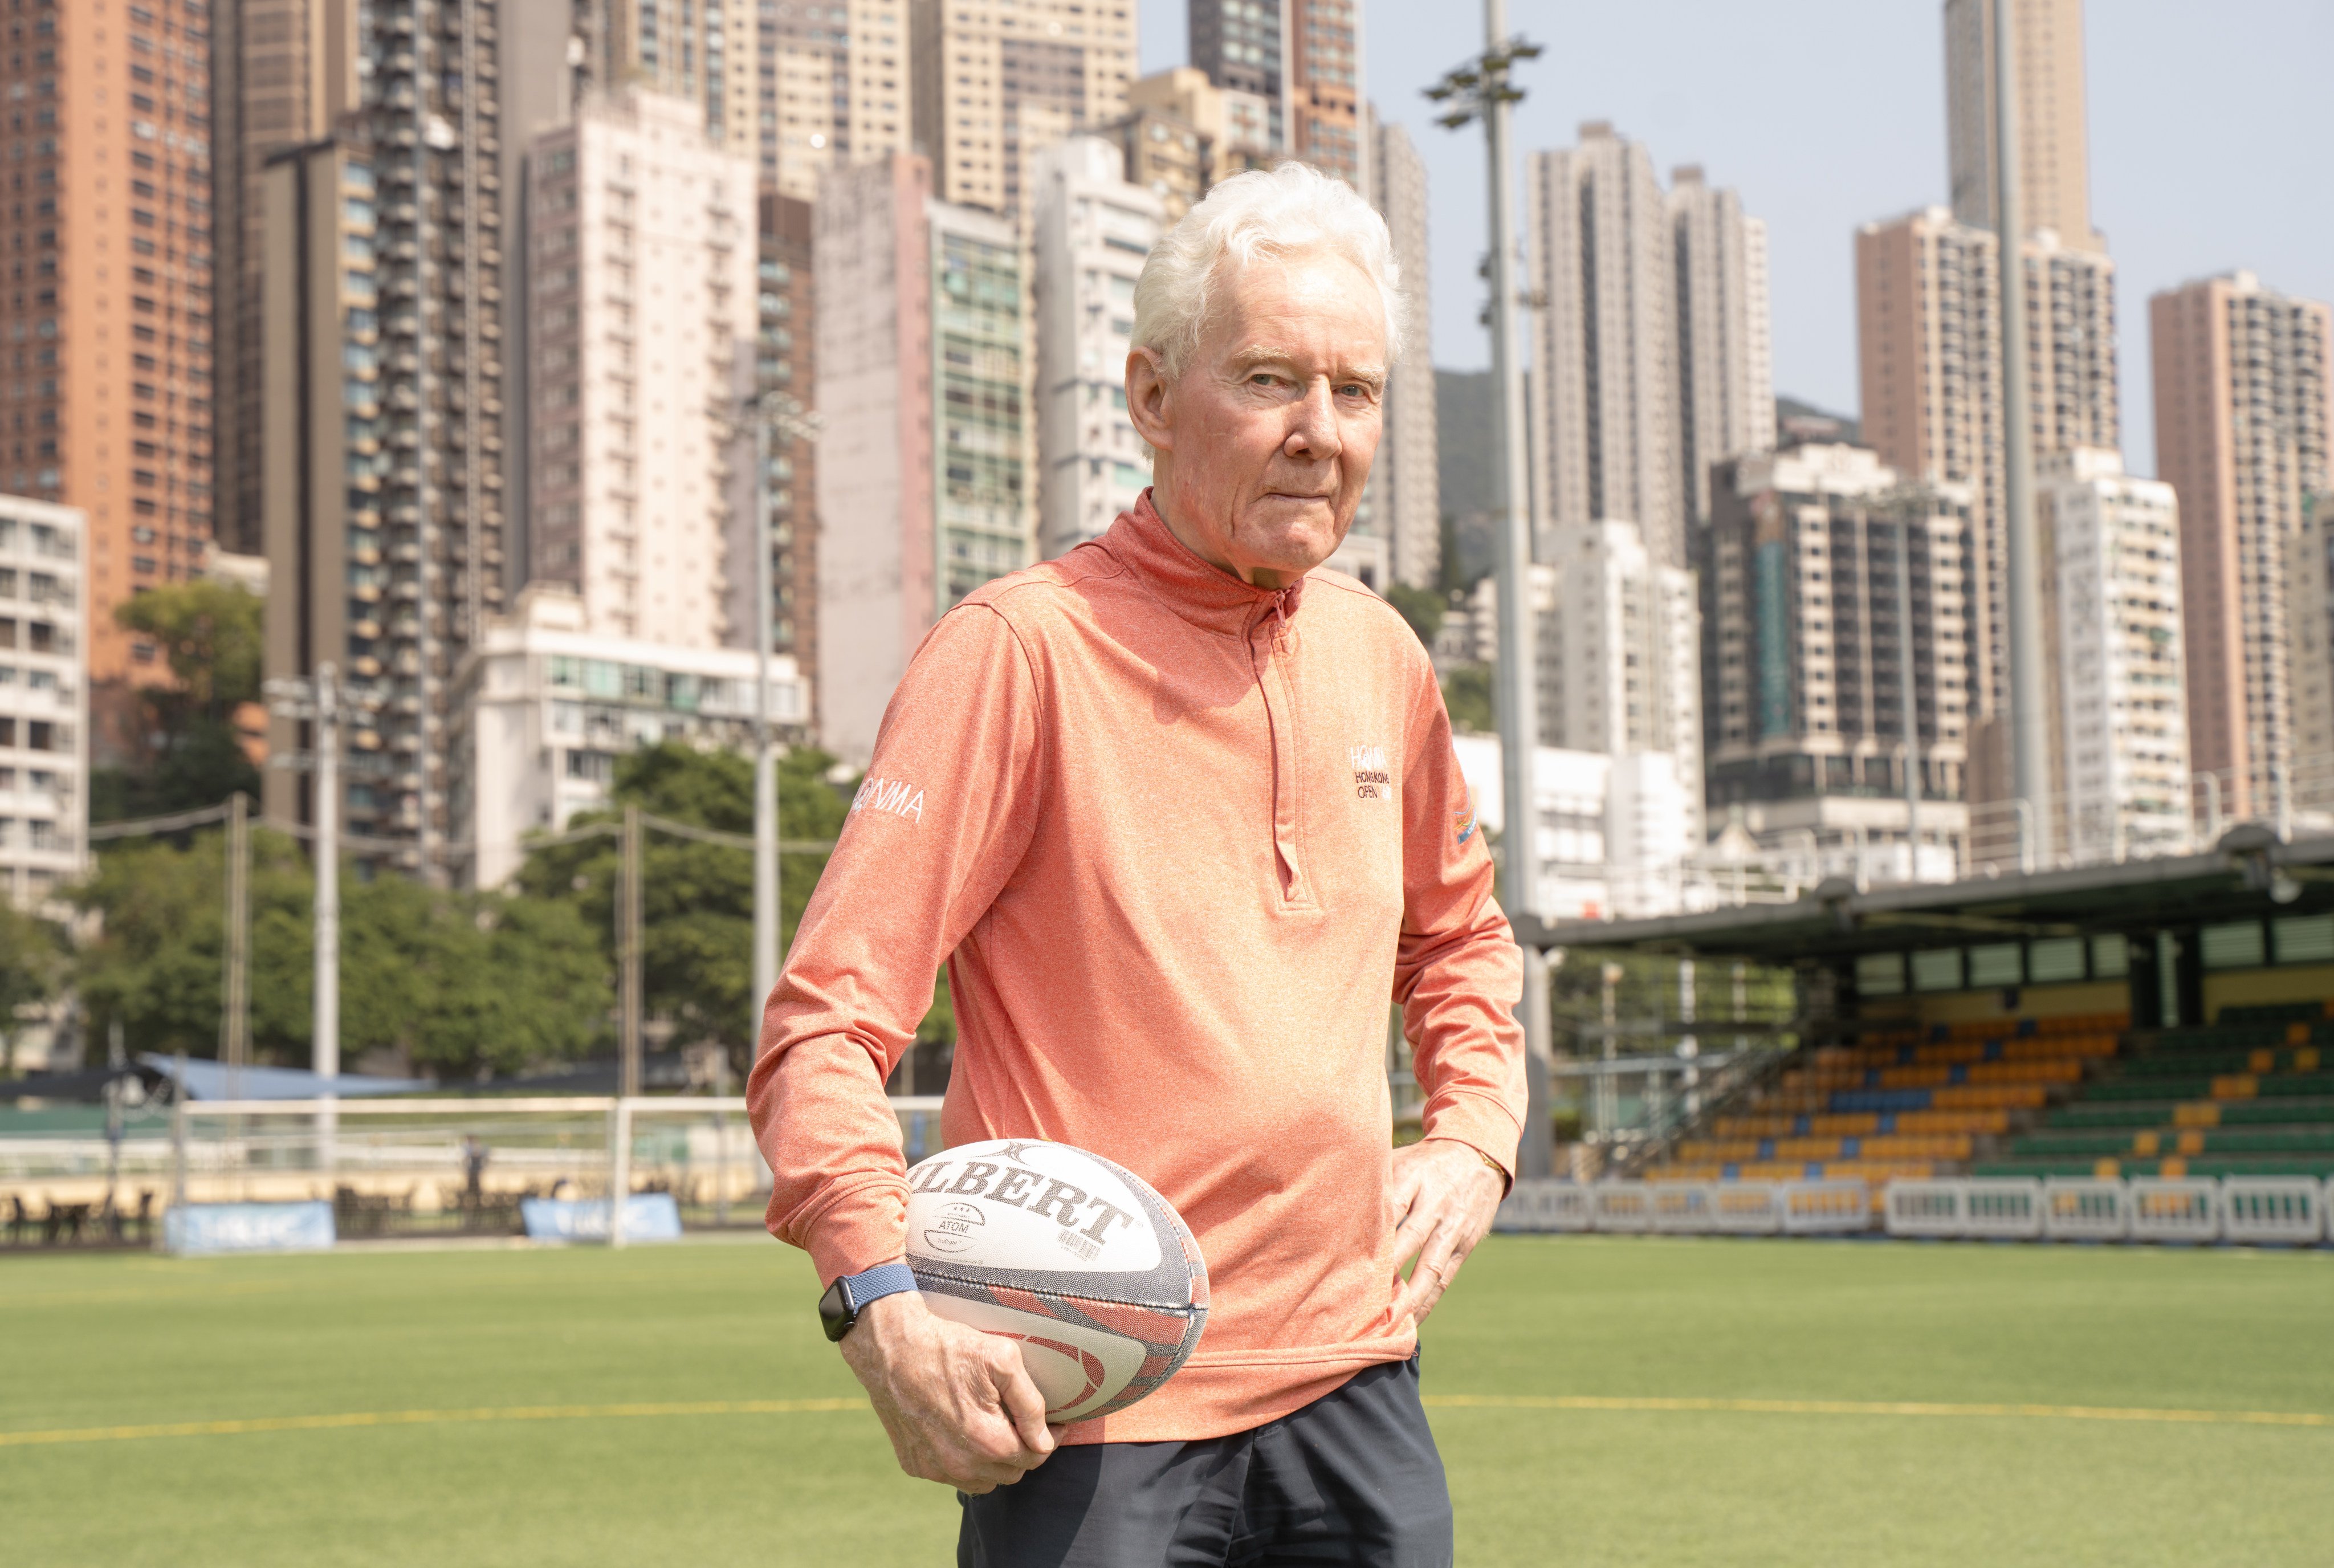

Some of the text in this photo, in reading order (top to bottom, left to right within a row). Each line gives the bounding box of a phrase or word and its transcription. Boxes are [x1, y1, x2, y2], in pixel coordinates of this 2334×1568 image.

[1358, 785, 1378, 799] OPEN
[909, 1161, 1135, 1246] ILBERT
[938, 1220, 969, 1233] ATOM
